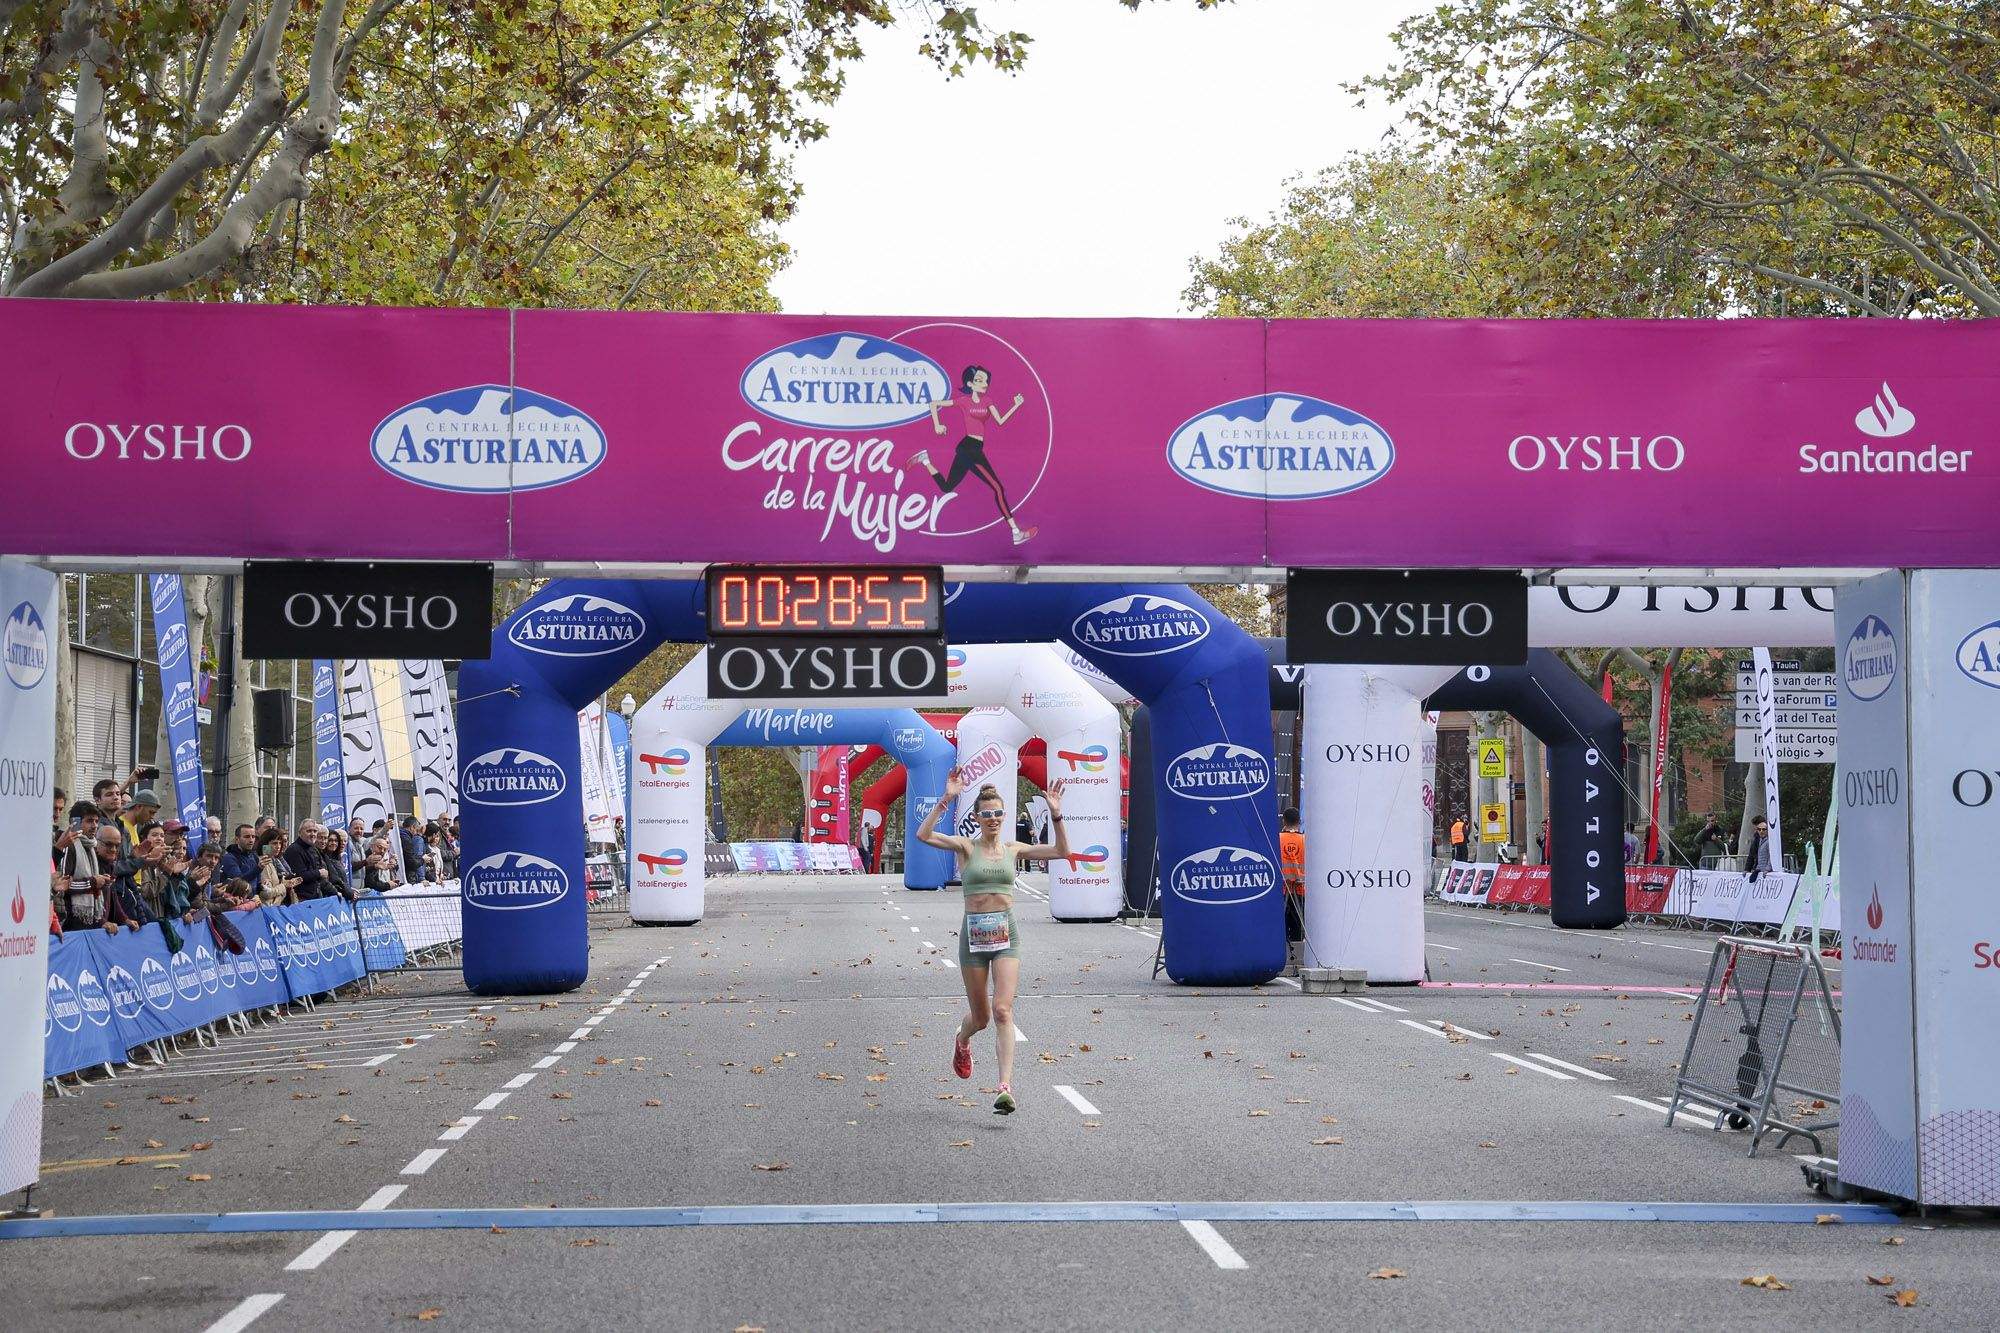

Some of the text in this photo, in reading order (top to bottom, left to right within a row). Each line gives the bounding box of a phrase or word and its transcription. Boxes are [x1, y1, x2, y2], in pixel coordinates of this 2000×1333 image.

[789, 364, 928, 377] CENTRAL LECHERA
[756, 366, 936, 405] ASTURIANA
[426, 422, 582, 433] CENTRAL LECHERA
[1220, 429, 1370, 441] CENTRAL LECHERA
[64, 423, 252, 461] OYSHO
[388, 424, 589, 465] ASTURIANA
[721, 421, 897, 474] Carrera
[1184, 431, 1377, 471] ASTURIANA
[1507, 435, 1686, 472] OYSHO
[1799, 443, 1973, 474] Santander
[763, 469, 959, 554] de la Mujer
[284, 592, 458, 631] OYSHO
[721, 576, 928, 626] 00:28:52
[516, 619, 635, 641] ASTURIANA
[587, 615, 633, 623] LECHERA
[1100, 612, 1195, 625] CENTRAL LECHERA
[1326, 601, 1493, 637] OYSHO
[1083, 620, 1202, 643] ASTURIANA
[5, 629, 45, 669] ASTURIANA
[718, 645, 937, 692] OYSHO
[1741, 661, 1753, 669] Av.
[1776, 661, 1799, 669] Taulet
[1847, 651, 1894, 682] ASTURIANA
[1783, 677, 1801, 686] van
[1804, 675, 1822, 686] der
[745, 708, 834, 742] Marlene
[1791, 712, 1808, 723] del
[1812, 712, 1836, 723] Teat
[1754, 733, 1838, 746] Initut Cartog
[1326, 744, 1411, 763] OYSHO
[1761, 747, 1810, 759] ològic
[0, 758, 46, 799] OYSHO
[517, 767, 556, 775] LECHERA
[960, 747, 1002, 787] COSMO
[1172, 766, 1266, 789] ASTURIANA
[466, 771, 560, 794] ASTURIANA
[639, 780, 690, 789] TotalEnergies
[1846, 767, 1899, 807] OYSHO
[637, 817, 689, 826] totalenergies.es
[1586, 747, 1600, 905] VOLVO
[479, 870, 558, 879] CENTRAL LECHERA
[637, 880, 688, 889] TotalEnergies
[1058, 877, 1110, 886] TotalEnergies
[1177, 869, 1271, 892] ASTURIANA
[1327, 869, 1412, 888] OYSHO
[468, 875, 562, 898] ASTURIANA
[1714, 877, 1744, 899] OYSHO
[1753, 878, 1784, 900] OYSHO
[1853, 935, 1897, 964] Santander
